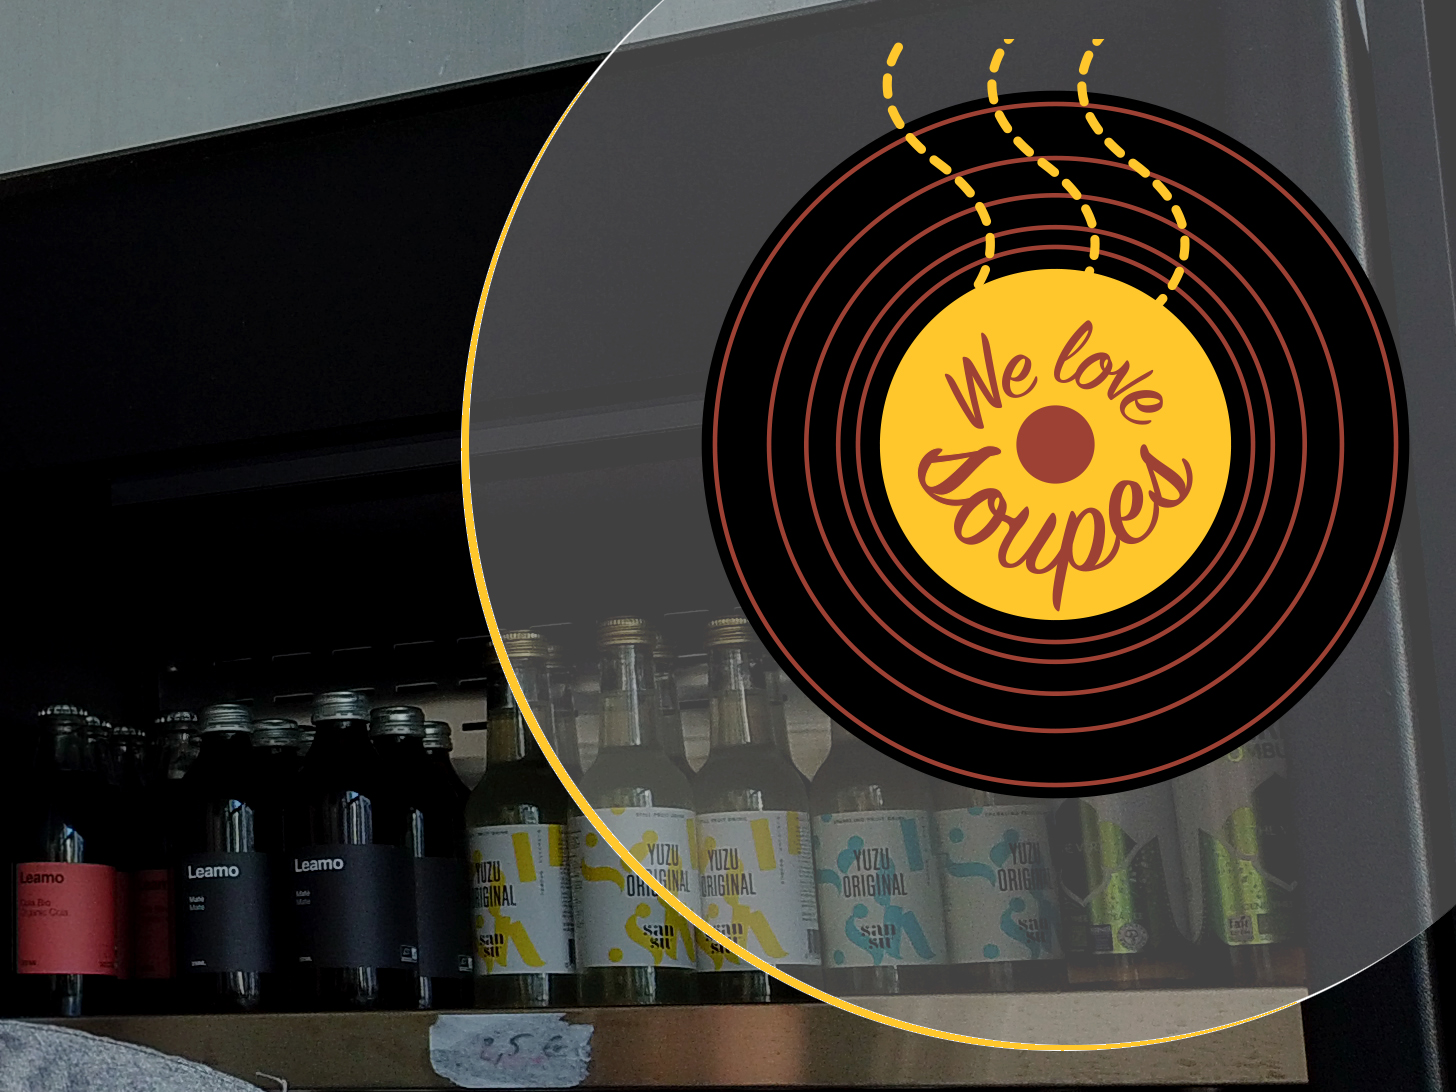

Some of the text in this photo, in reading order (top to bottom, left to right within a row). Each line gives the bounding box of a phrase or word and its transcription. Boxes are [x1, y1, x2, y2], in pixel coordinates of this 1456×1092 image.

[647, 843, 679, 866] YUZU
[707, 848, 738, 871] YUZU
[853, 848, 890, 871] YUZU
[1009, 842, 1042, 866] YUZU
[187, 865, 240, 879] Leamo
[294, 858, 344, 873] Leamo
[475, 860, 501, 884] YUZU
[20, 871, 64, 884] Leamo
[701, 873, 756, 897] ORIGINAL
[842, 873, 908, 898] ORIGINAL
[643, 923, 674, 937] san
[860, 923, 897, 937] san
[1018, 918, 1048, 932] san
[479, 933, 504, 945] san
